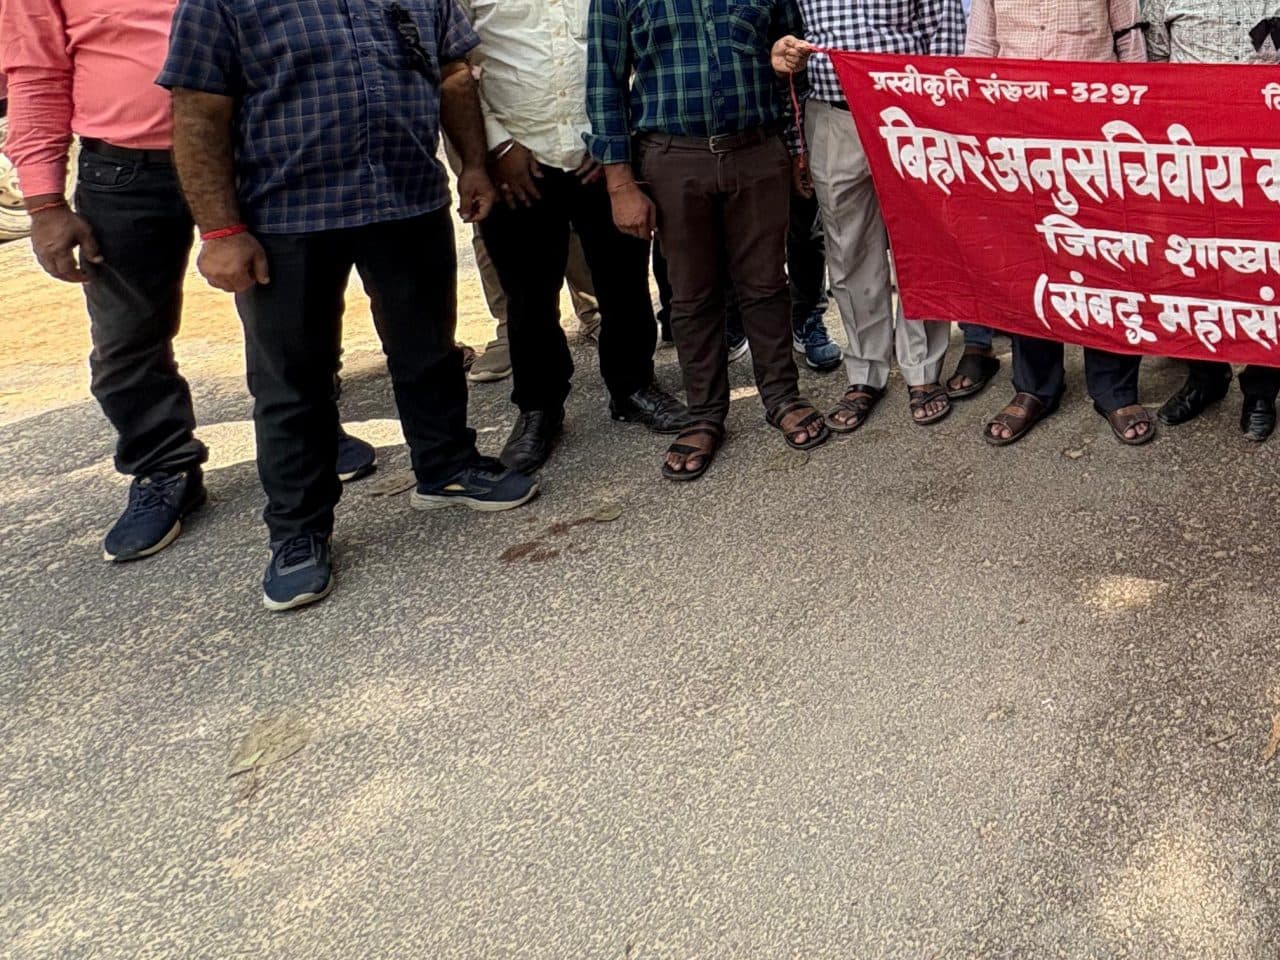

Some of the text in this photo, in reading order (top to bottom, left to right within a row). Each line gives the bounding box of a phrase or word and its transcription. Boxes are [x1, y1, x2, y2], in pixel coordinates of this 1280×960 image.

[867, 63, 971, 107] प्रस्वीकृति
[878, 105, 997, 195] बिहार
[985, 119, 1248, 216] अनुसचिवीय
[1035, 213, 1154, 271] जिला
